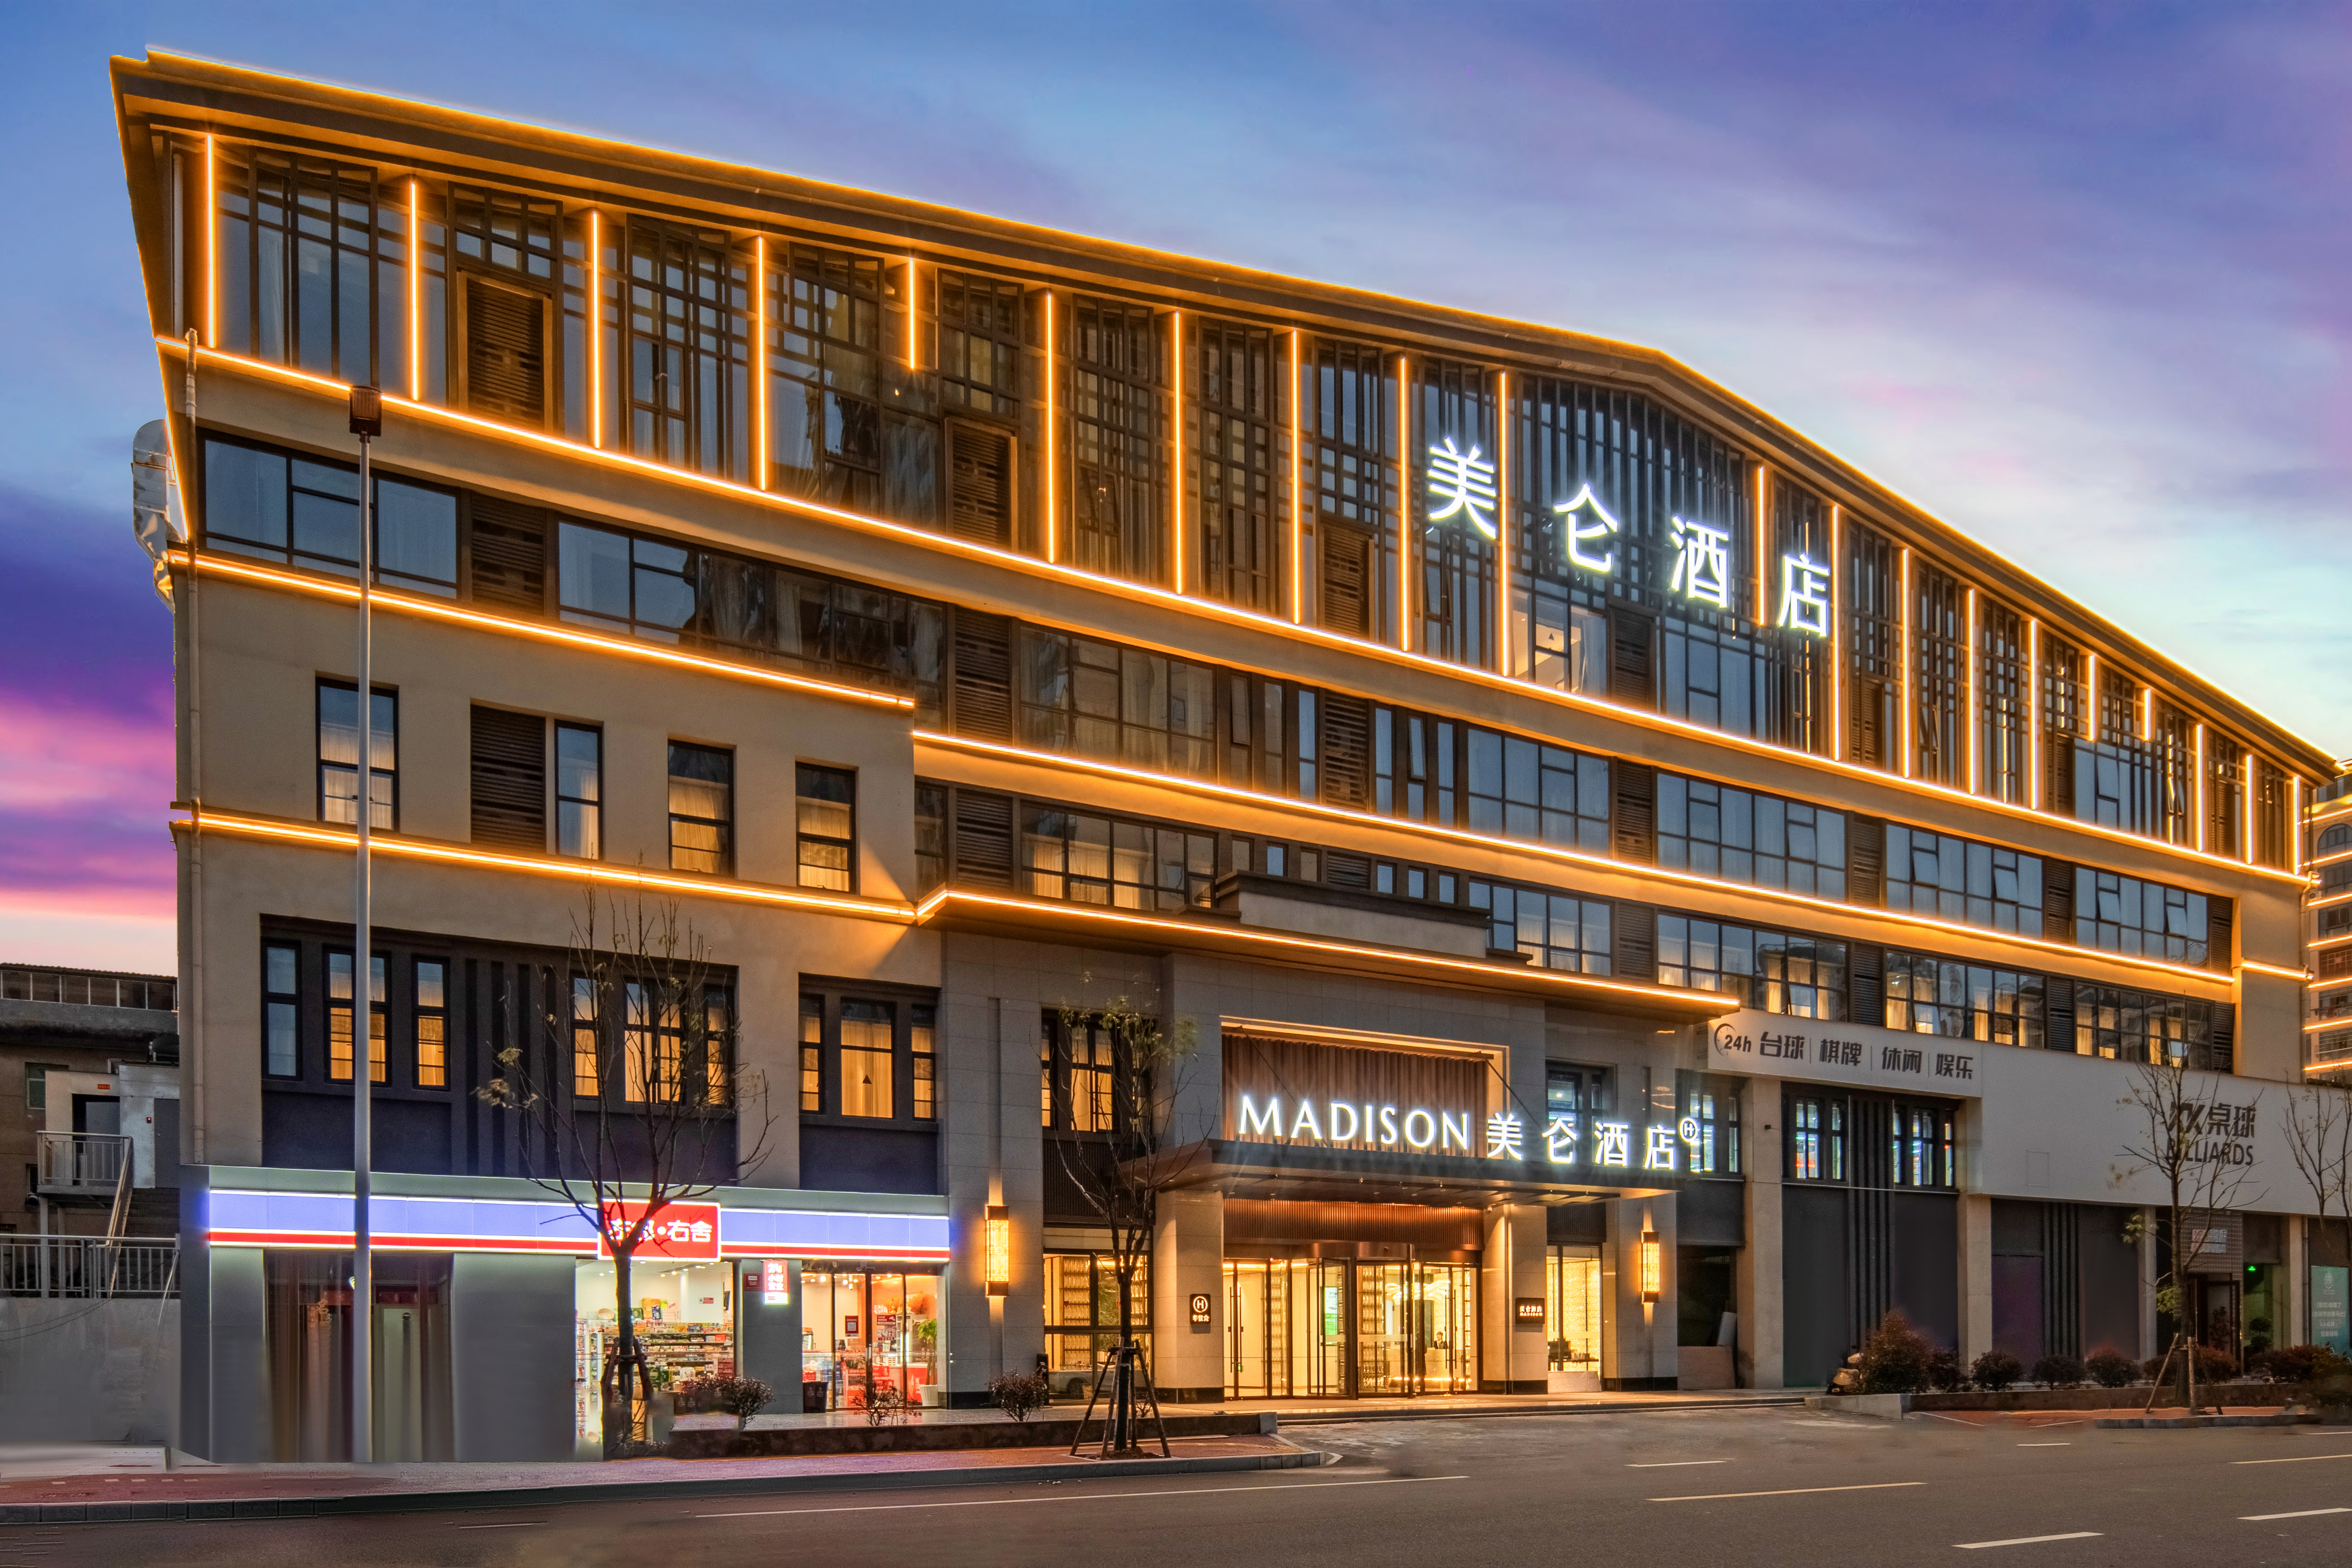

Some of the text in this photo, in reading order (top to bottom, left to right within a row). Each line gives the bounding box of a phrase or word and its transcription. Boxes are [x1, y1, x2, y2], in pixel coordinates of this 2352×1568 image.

[1427, 435, 1831, 638] 美仑酒店
[1723, 1031, 1974, 1080] 24h 台球 棋牌 休闲 娱乐
[1238, 1095, 1469, 1151] MADISON
[1486, 1112, 1676, 1171] 美仑酒店
